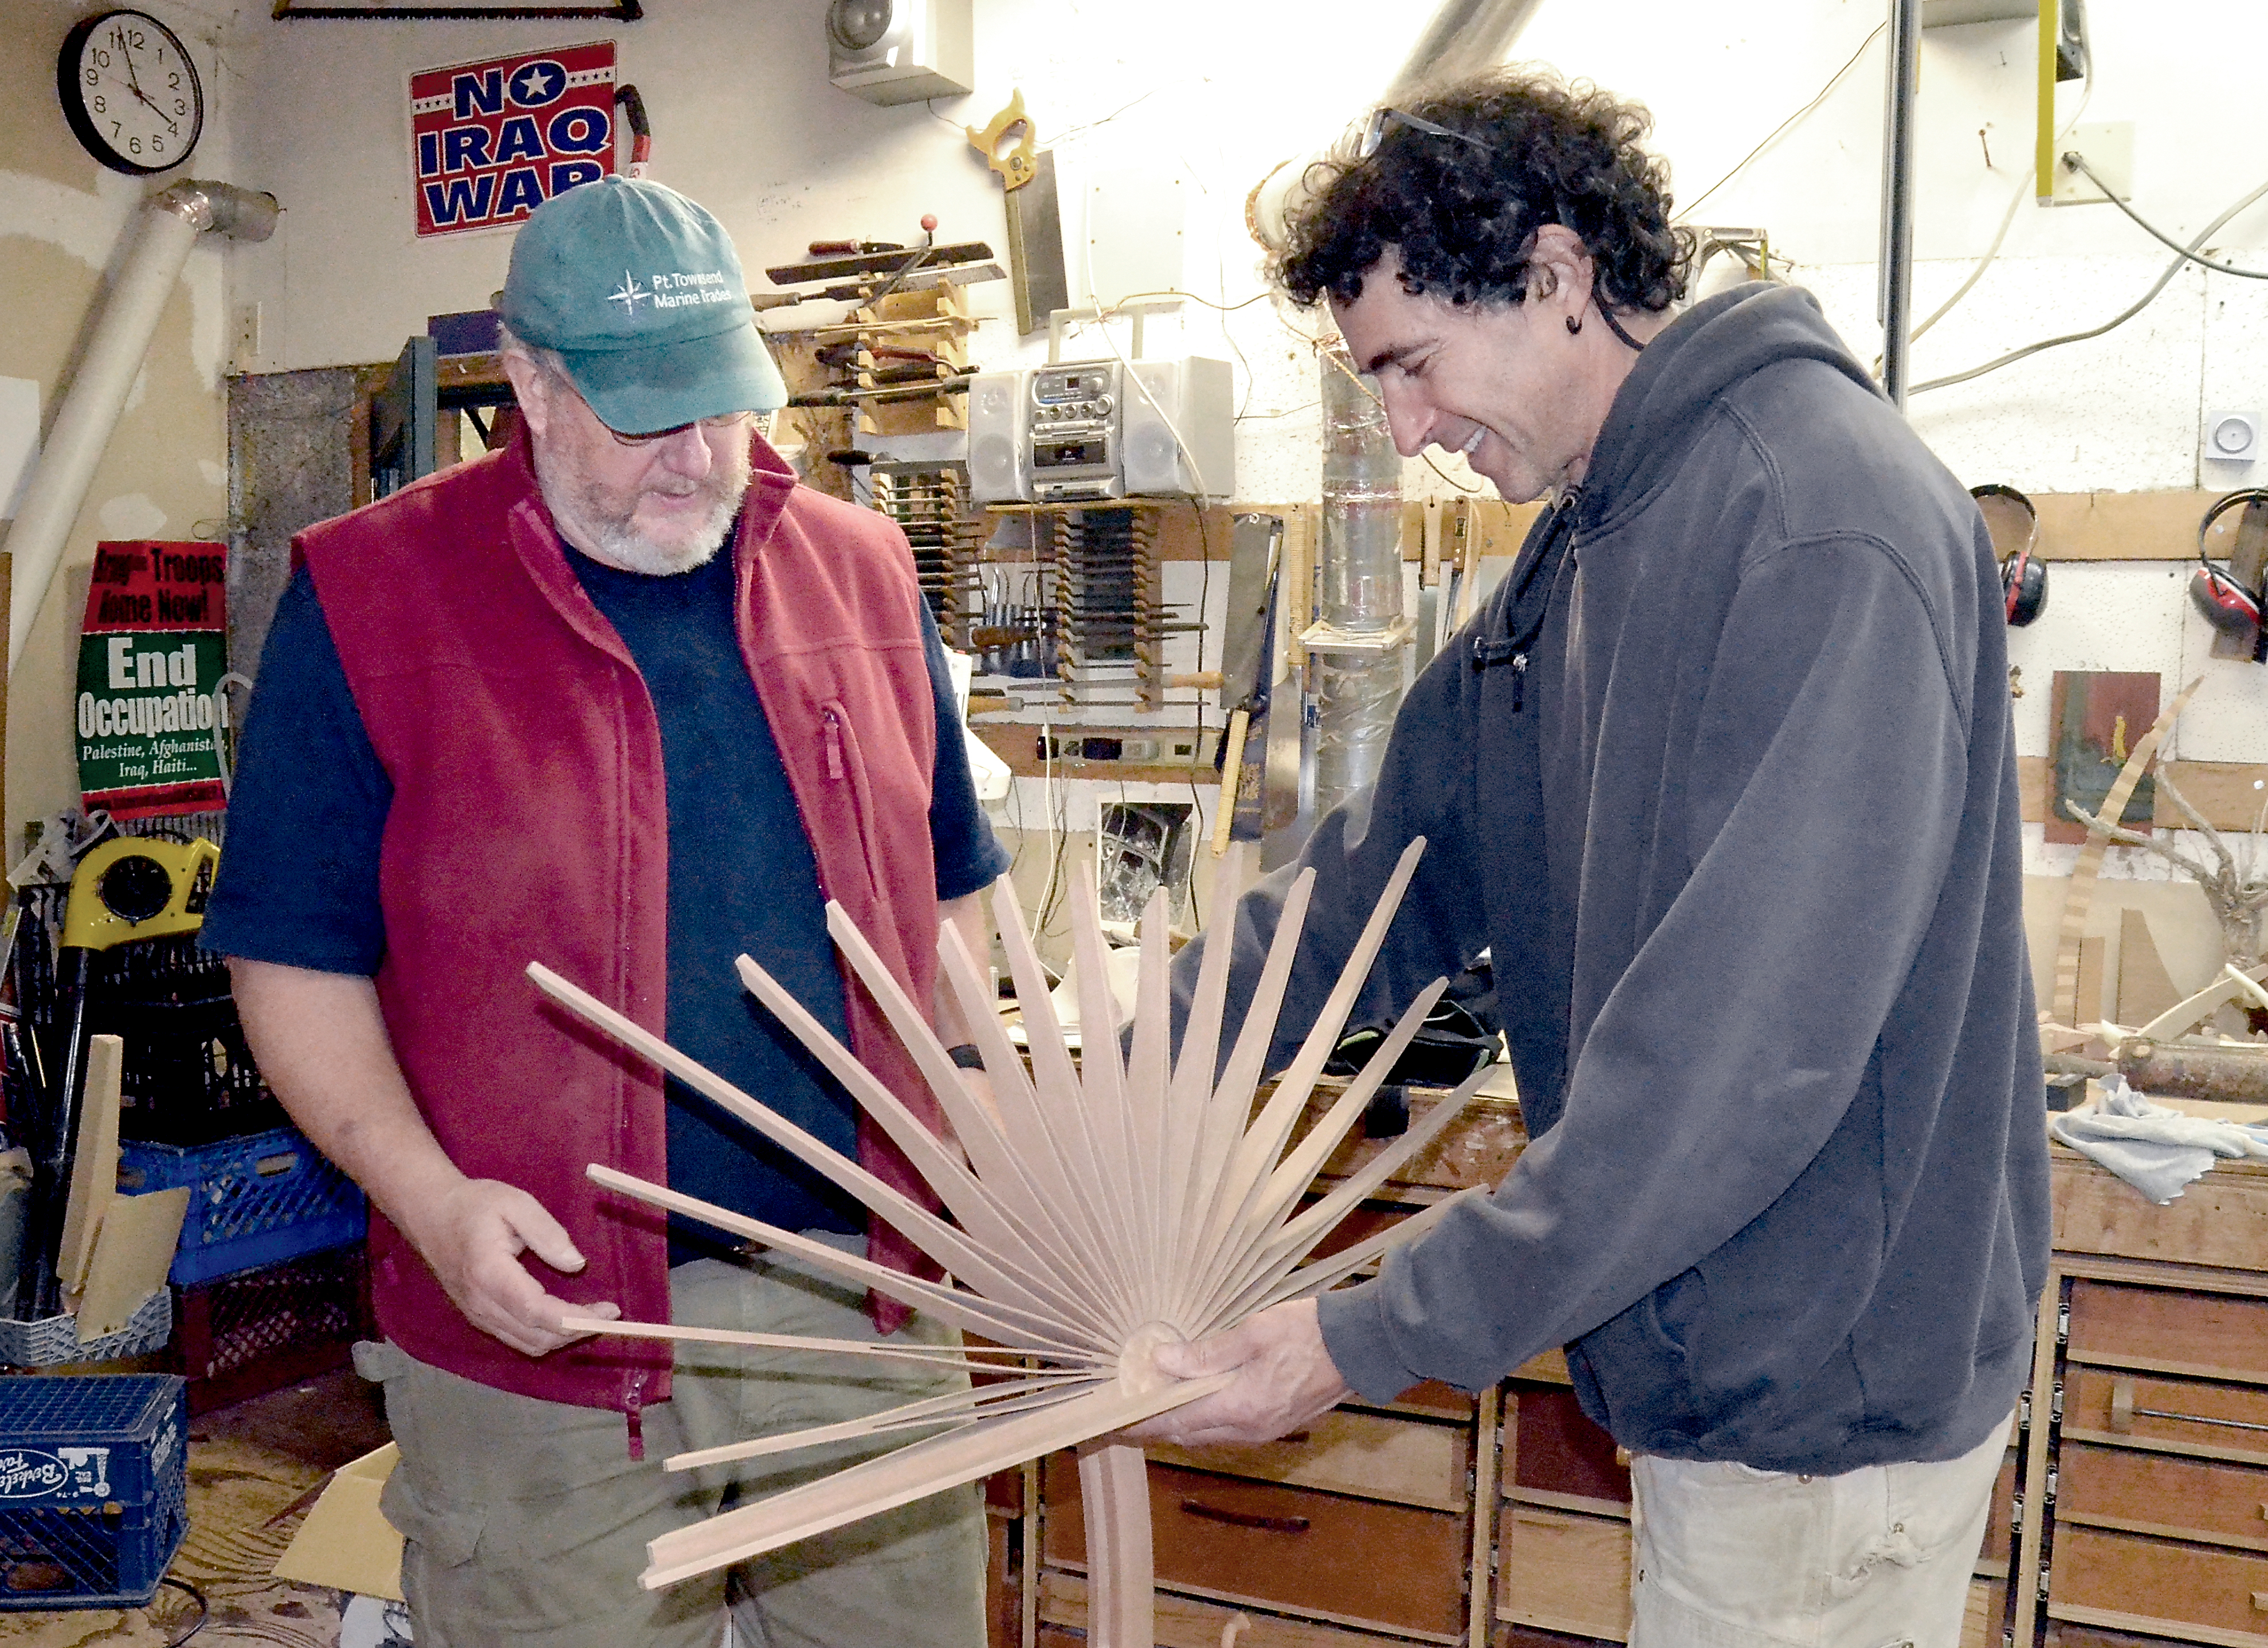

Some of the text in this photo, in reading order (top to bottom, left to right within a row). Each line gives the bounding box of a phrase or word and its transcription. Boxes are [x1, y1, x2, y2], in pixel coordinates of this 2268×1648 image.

[109, 31, 123, 50] 11
[128, 30, 144, 50] 12
[92, 48, 109, 68] 10
[158, 48, 162, 64] 1
[87, 68, 99, 86] 9
[168, 72, 179, 91] 2
[451, 59, 568, 121] NO
[94, 96, 106, 113] 8
[174, 99, 186, 116] 3
[111, 121, 121, 139] 7
[168, 122, 179, 138] 4
[130, 137, 141, 154] 6
[152, 135, 164, 152] 5
[418, 105, 611, 178] IRAQ
[653, 270, 723, 289] Pt. Townsend
[654, 289, 732, 308] Marine Trades
[150, 547, 224, 585] Troops
[158, 588, 209, 623] Now!
[108, 637, 197, 689] End
[83, 738, 228, 760] Palestine, Afghanist,
[119, 758, 197, 780] Iraq, Haiti...
